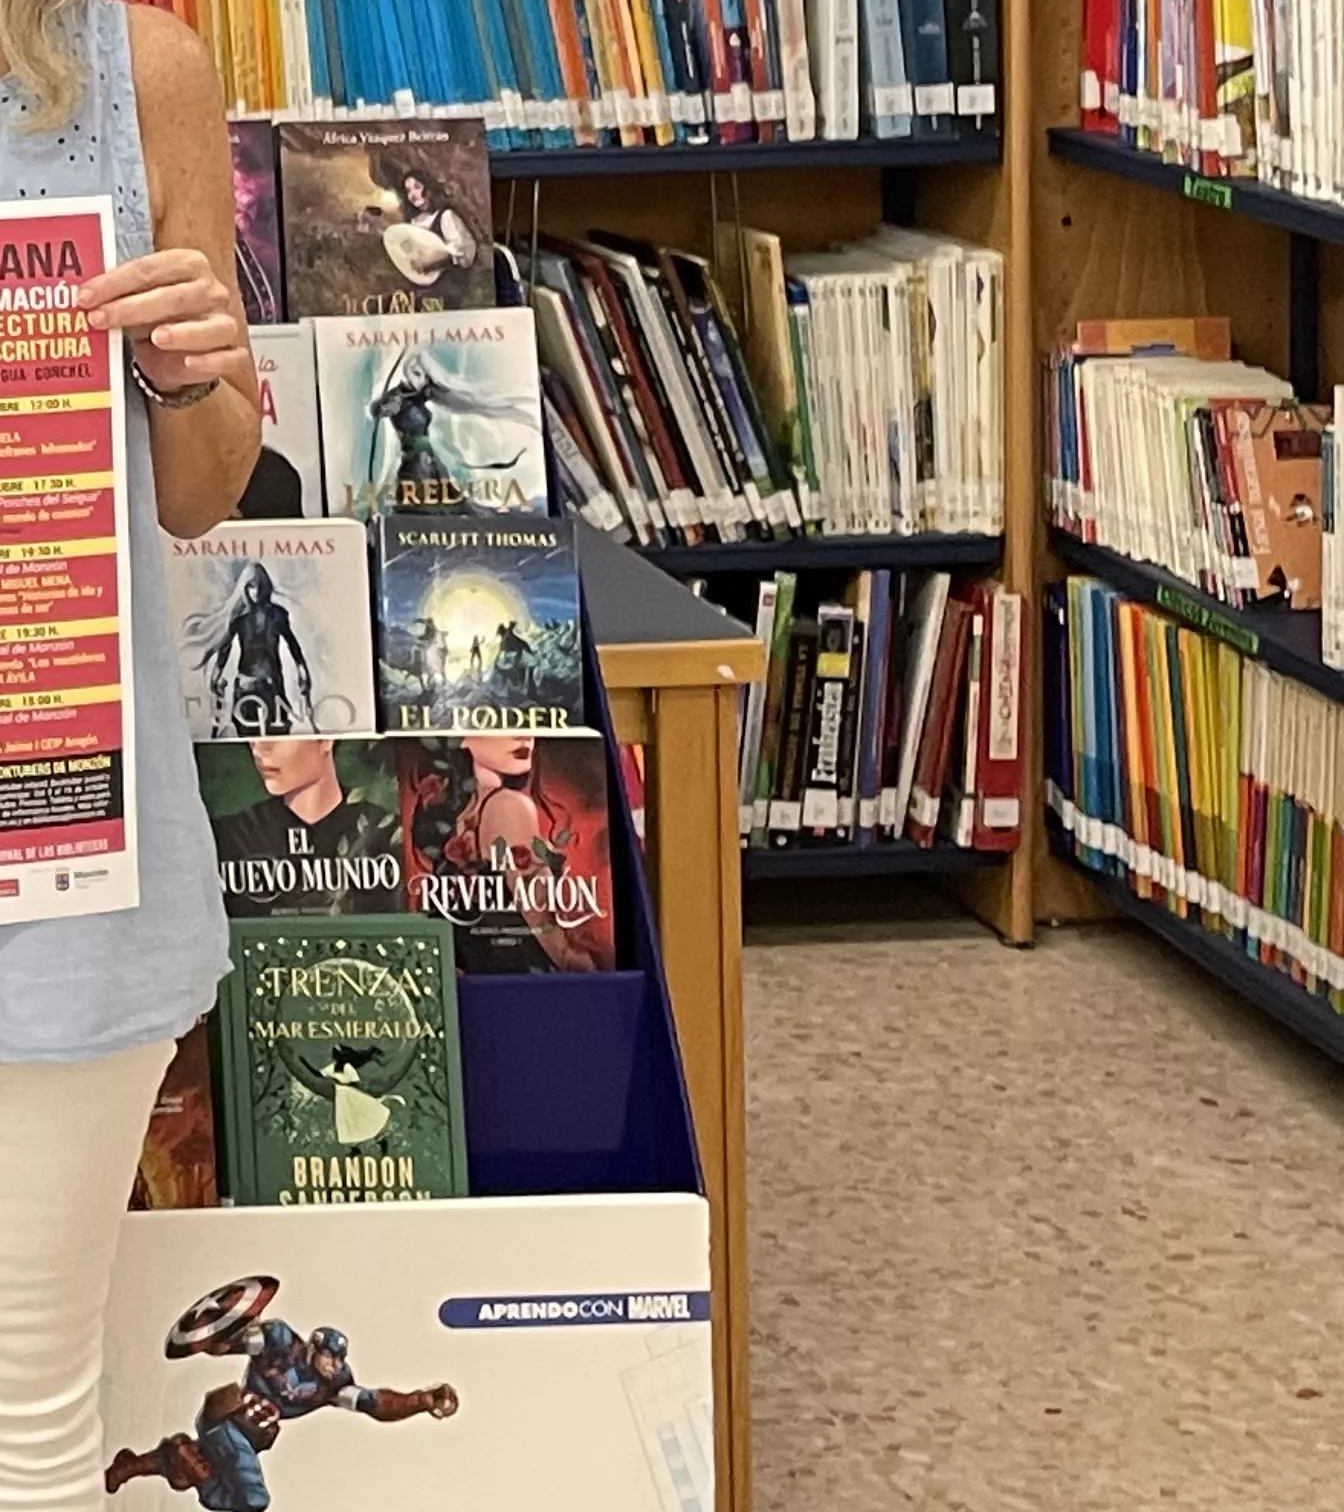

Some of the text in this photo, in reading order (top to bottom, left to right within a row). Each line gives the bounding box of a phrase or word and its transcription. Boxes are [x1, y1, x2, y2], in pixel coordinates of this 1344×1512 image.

[346, 329, 419, 347] SARAH
[445, 325, 505, 343] MAAS
[35, 362, 93, 382] CONCHEL
[173, 539, 248, 557] SARAH
[275, 537, 335, 556] MAAS
[485, 532, 557, 548] THOMAS
[288, 827, 315, 855] EL
[490, 845, 517, 872] LA
[301, 853, 400, 891] MUNDO
[416, 866, 604, 922] REVELACIÓN
[264, 966, 421, 998] TRENZA
[256, 1020, 435, 1039] MAR ESMERALDA
[293, 1156, 413, 1189] BRANDON
[478, 1295, 690, 1320] APRENDO CON MARVEL
